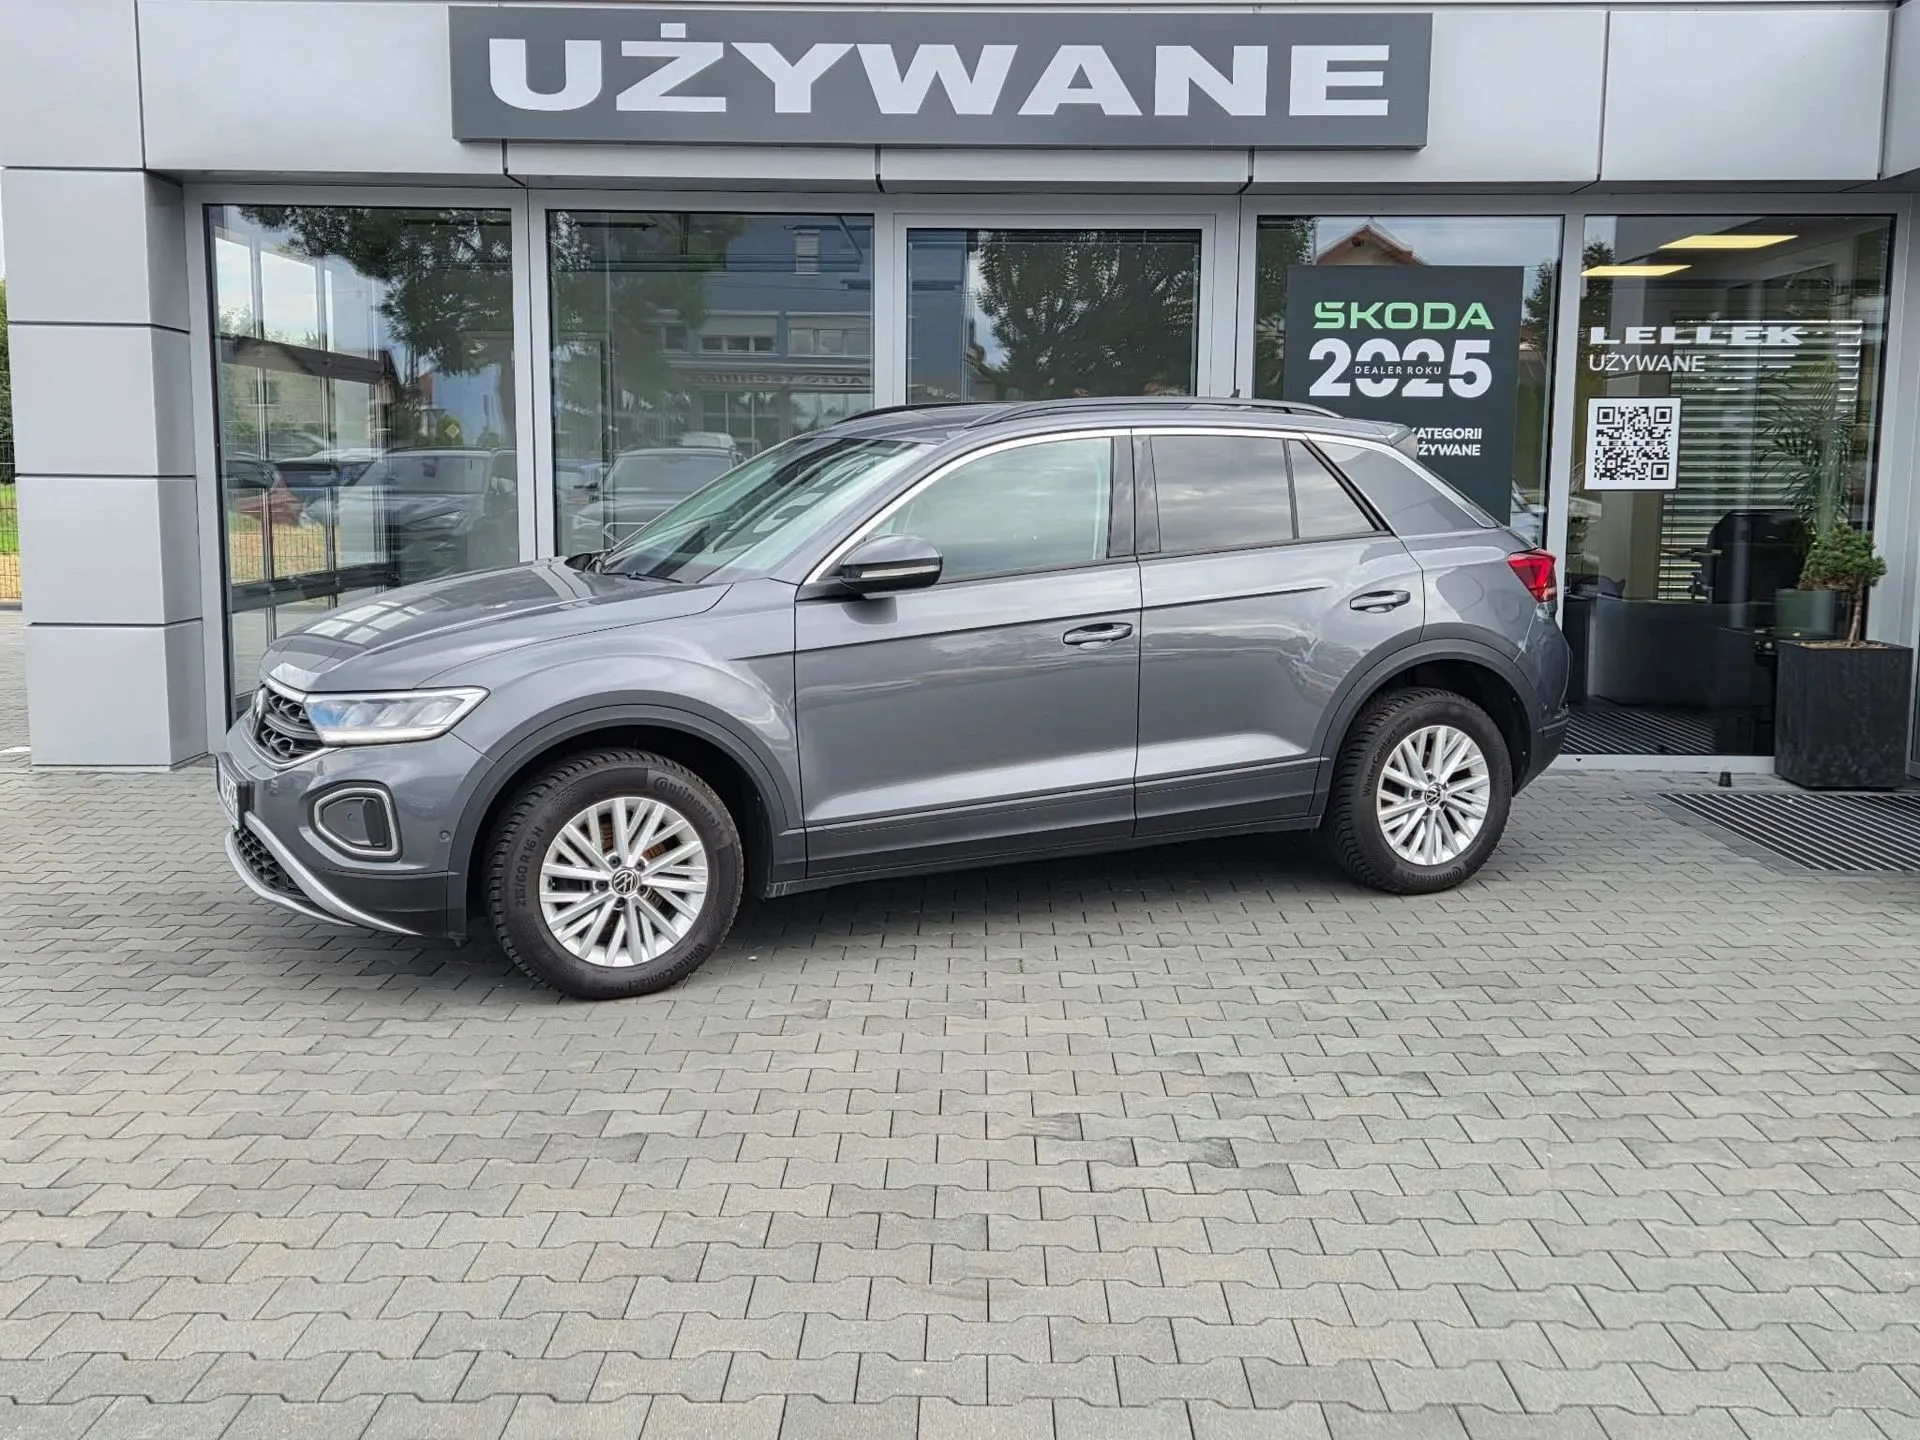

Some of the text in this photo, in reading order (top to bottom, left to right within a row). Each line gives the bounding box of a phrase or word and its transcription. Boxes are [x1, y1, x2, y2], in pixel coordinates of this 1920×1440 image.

[488, 22, 1389, 116] UŻYWANE
[1590, 326, 1803, 345] LELLEK
[1309, 338, 1492, 398] 2025
[1355, 366, 1442, 375] DEALER ROKU
[1589, 352, 1706, 372] UŻYWANE
[1412, 427, 1482, 440] ATEGORII
[1417, 441, 1481, 456] ŻYWANE
